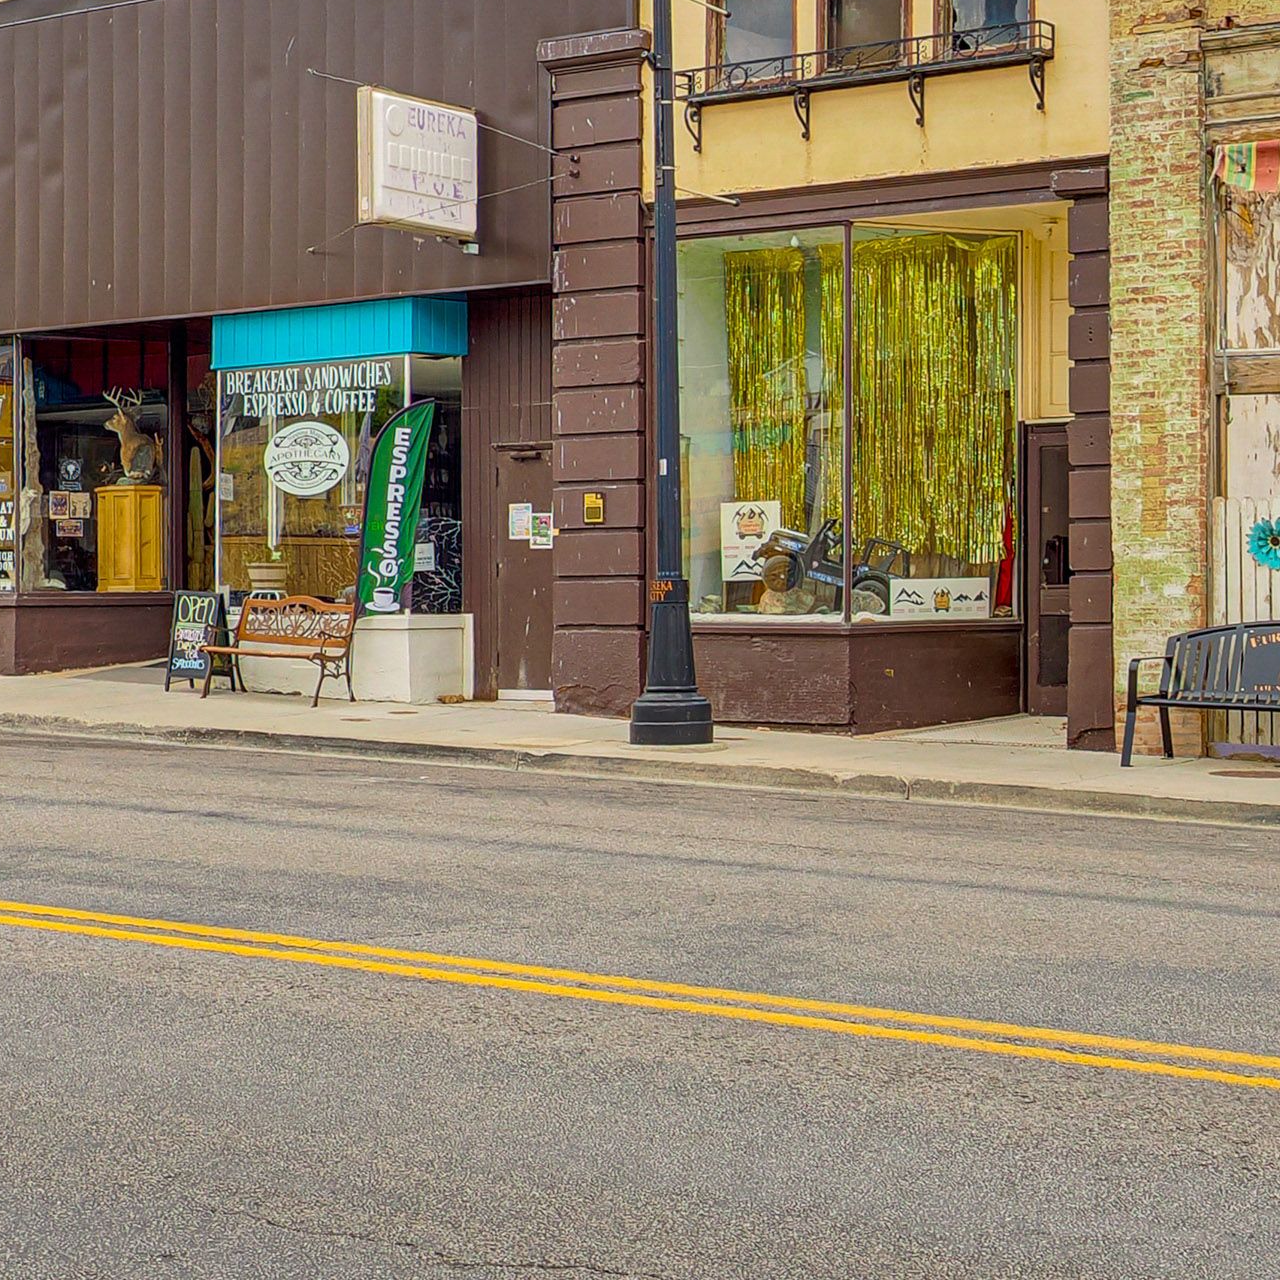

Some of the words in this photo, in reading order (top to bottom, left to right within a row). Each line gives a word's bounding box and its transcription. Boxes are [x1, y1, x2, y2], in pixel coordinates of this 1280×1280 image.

[408, 107, 466, 139] EUREKA
[226, 368, 300, 396] BREAKFAST
[304, 360, 391, 392] SANDWICHES
[243, 391, 307, 418] ESPRESSO
[311, 391, 320, 417] &
[324, 389, 376, 415] COFFEE
[379, 426, 412, 577] ESPRESSO
[0, 515, 7, 528] &
[178, 595, 216, 626] OPEN
